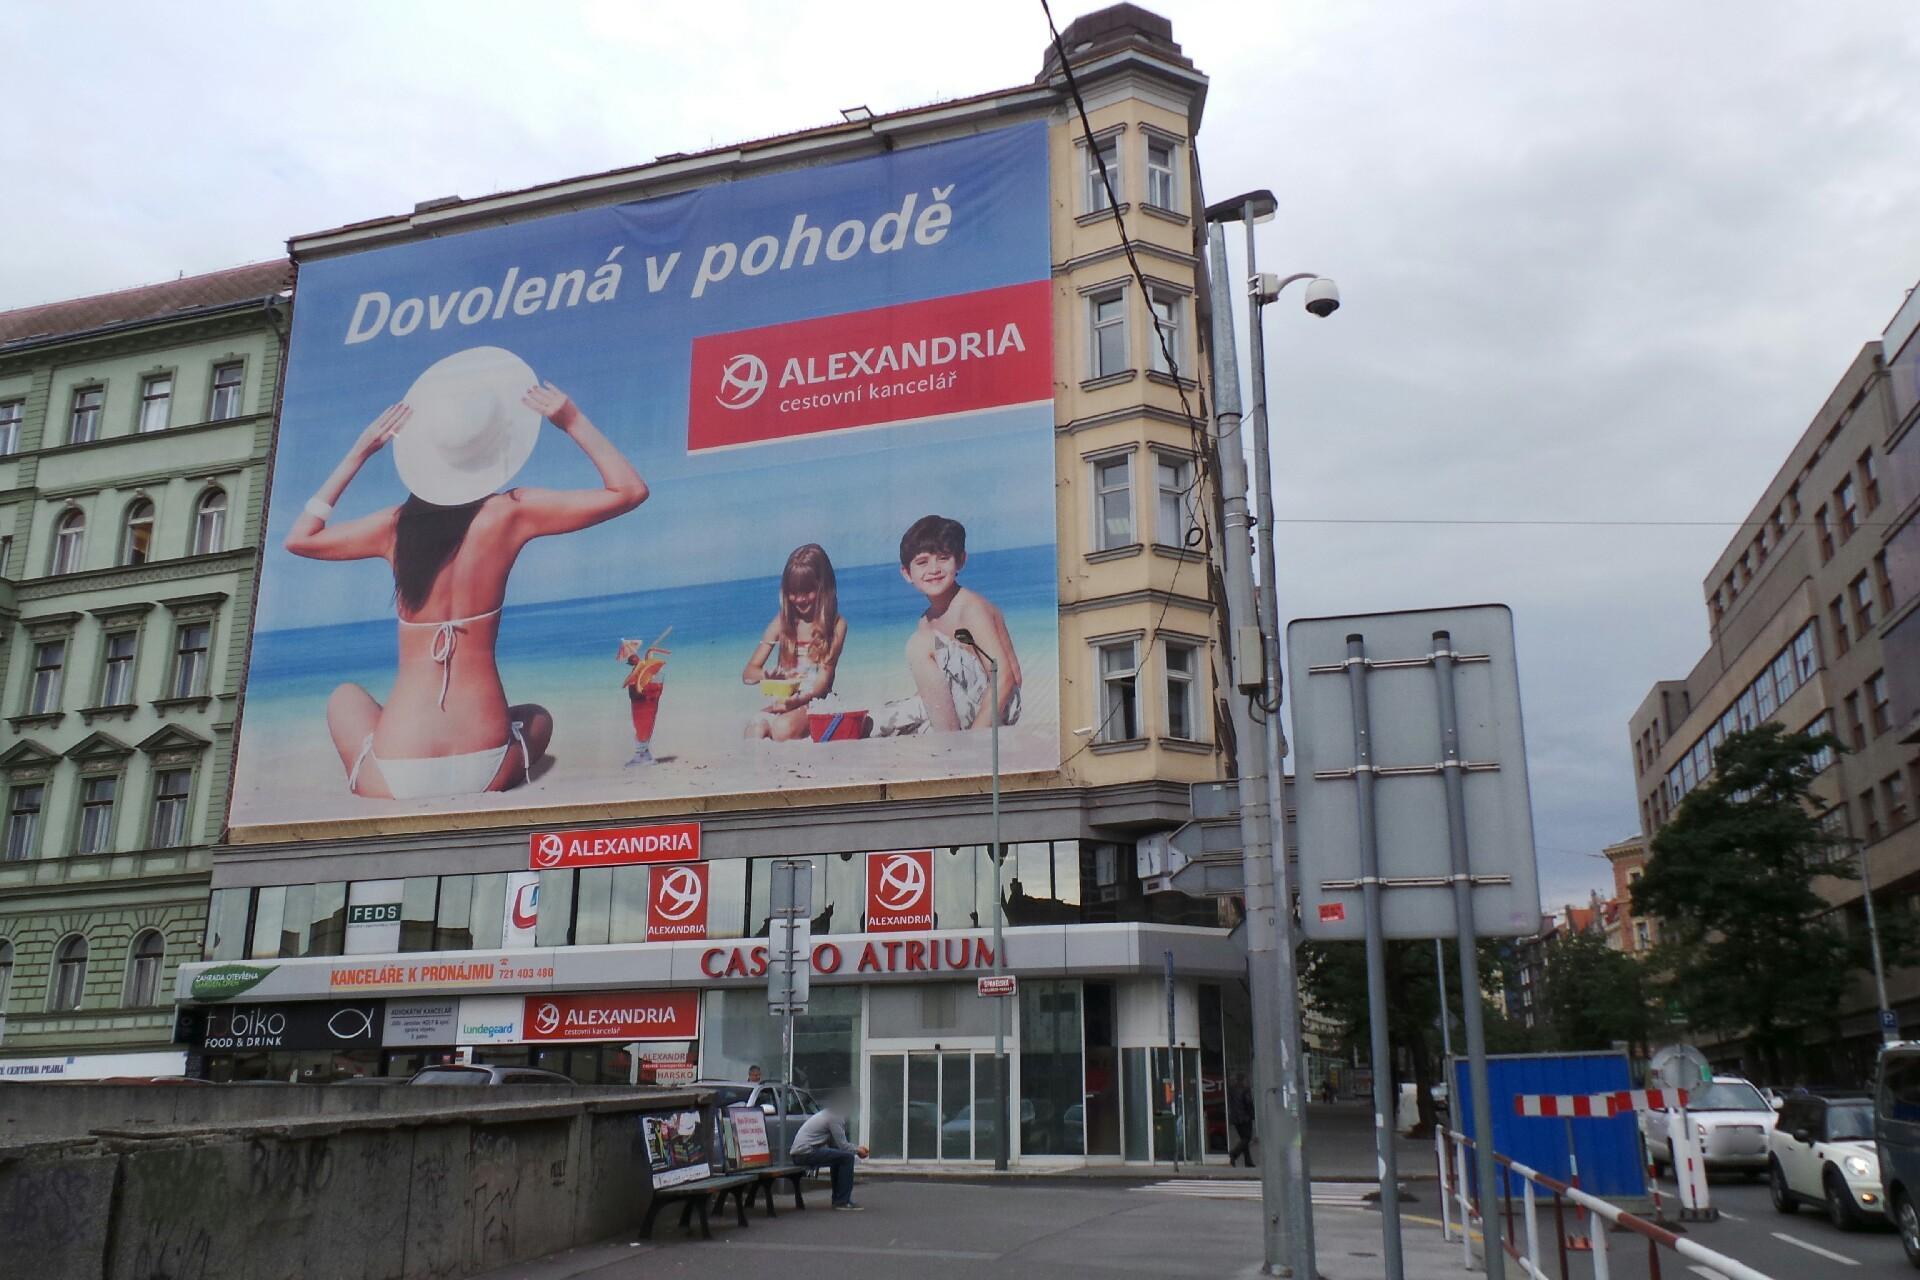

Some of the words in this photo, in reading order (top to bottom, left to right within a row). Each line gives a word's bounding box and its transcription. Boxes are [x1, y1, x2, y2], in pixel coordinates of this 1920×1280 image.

[344, 246, 624, 346] Dovolená
[645, 251, 680, 294] v
[691, 184, 956, 299] pohodě
[779, 322, 1026, 389] ALEXANDRIA
[779, 384, 863, 413] cestovní
[869, 370, 958, 400] kancelář
[568, 832, 693, 858] ALEXANDRIA
[354, 905, 398, 921] FEDS
[868, 914, 932, 926] ALEXANDRIA
[648, 924, 706, 935] ALEXANDRIA
[700, 942, 842, 978] CASO
[857, 936, 1008, 972] ATRIUM
[330, 963, 404, 986] KANCELÁŘE
[408, 967, 418, 982] K
[420, 960, 494, 982] PRONÁJMU
[499, 969, 514, 979] 721
[517, 968, 534, 978] 403
[206, 1007, 286, 1037] tbiko
[564, 1006, 676, 1026] ALEXANDRIA
[204, 1037, 233, 1048] FOOD
[236, 1037, 244, 1047] &
[246, 1036, 282, 1047] DRINK
[643, 1053, 693, 1061] ALEXANDR
